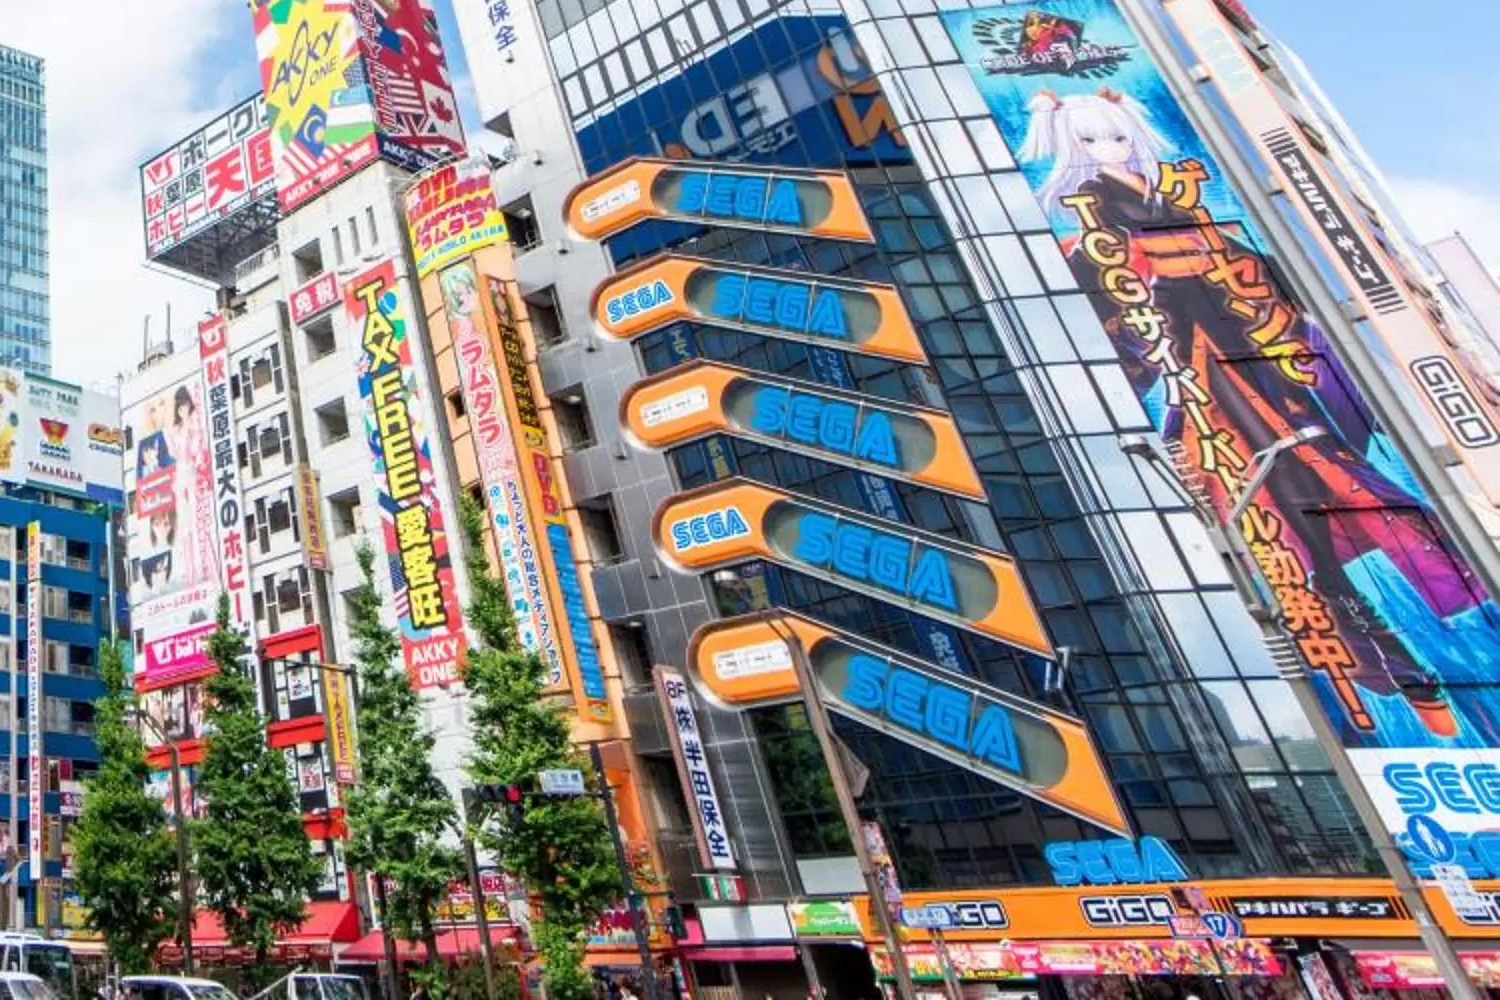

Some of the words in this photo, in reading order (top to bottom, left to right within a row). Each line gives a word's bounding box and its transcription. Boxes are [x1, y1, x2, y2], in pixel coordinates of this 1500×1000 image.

[308, 58, 338, 87] ONE
[674, 172, 803, 225] SEGA
[356, 277, 400, 374] TAX
[607, 280, 673, 323] SEGA
[711, 272, 849, 338] SEGA
[460, 338, 501, 446] ラムタラ
[370, 374, 421, 501] FREE
[752, 386, 899, 465] SEGA
[670, 507, 749, 550] SEGA
[793, 511, 960, 614] SEGA
[411, 642, 460, 666] AKKY
[418, 662, 459, 685] ONE
[842, 653, 1028, 776] SEGA
[1043, 835, 1192, 886] SEGA
